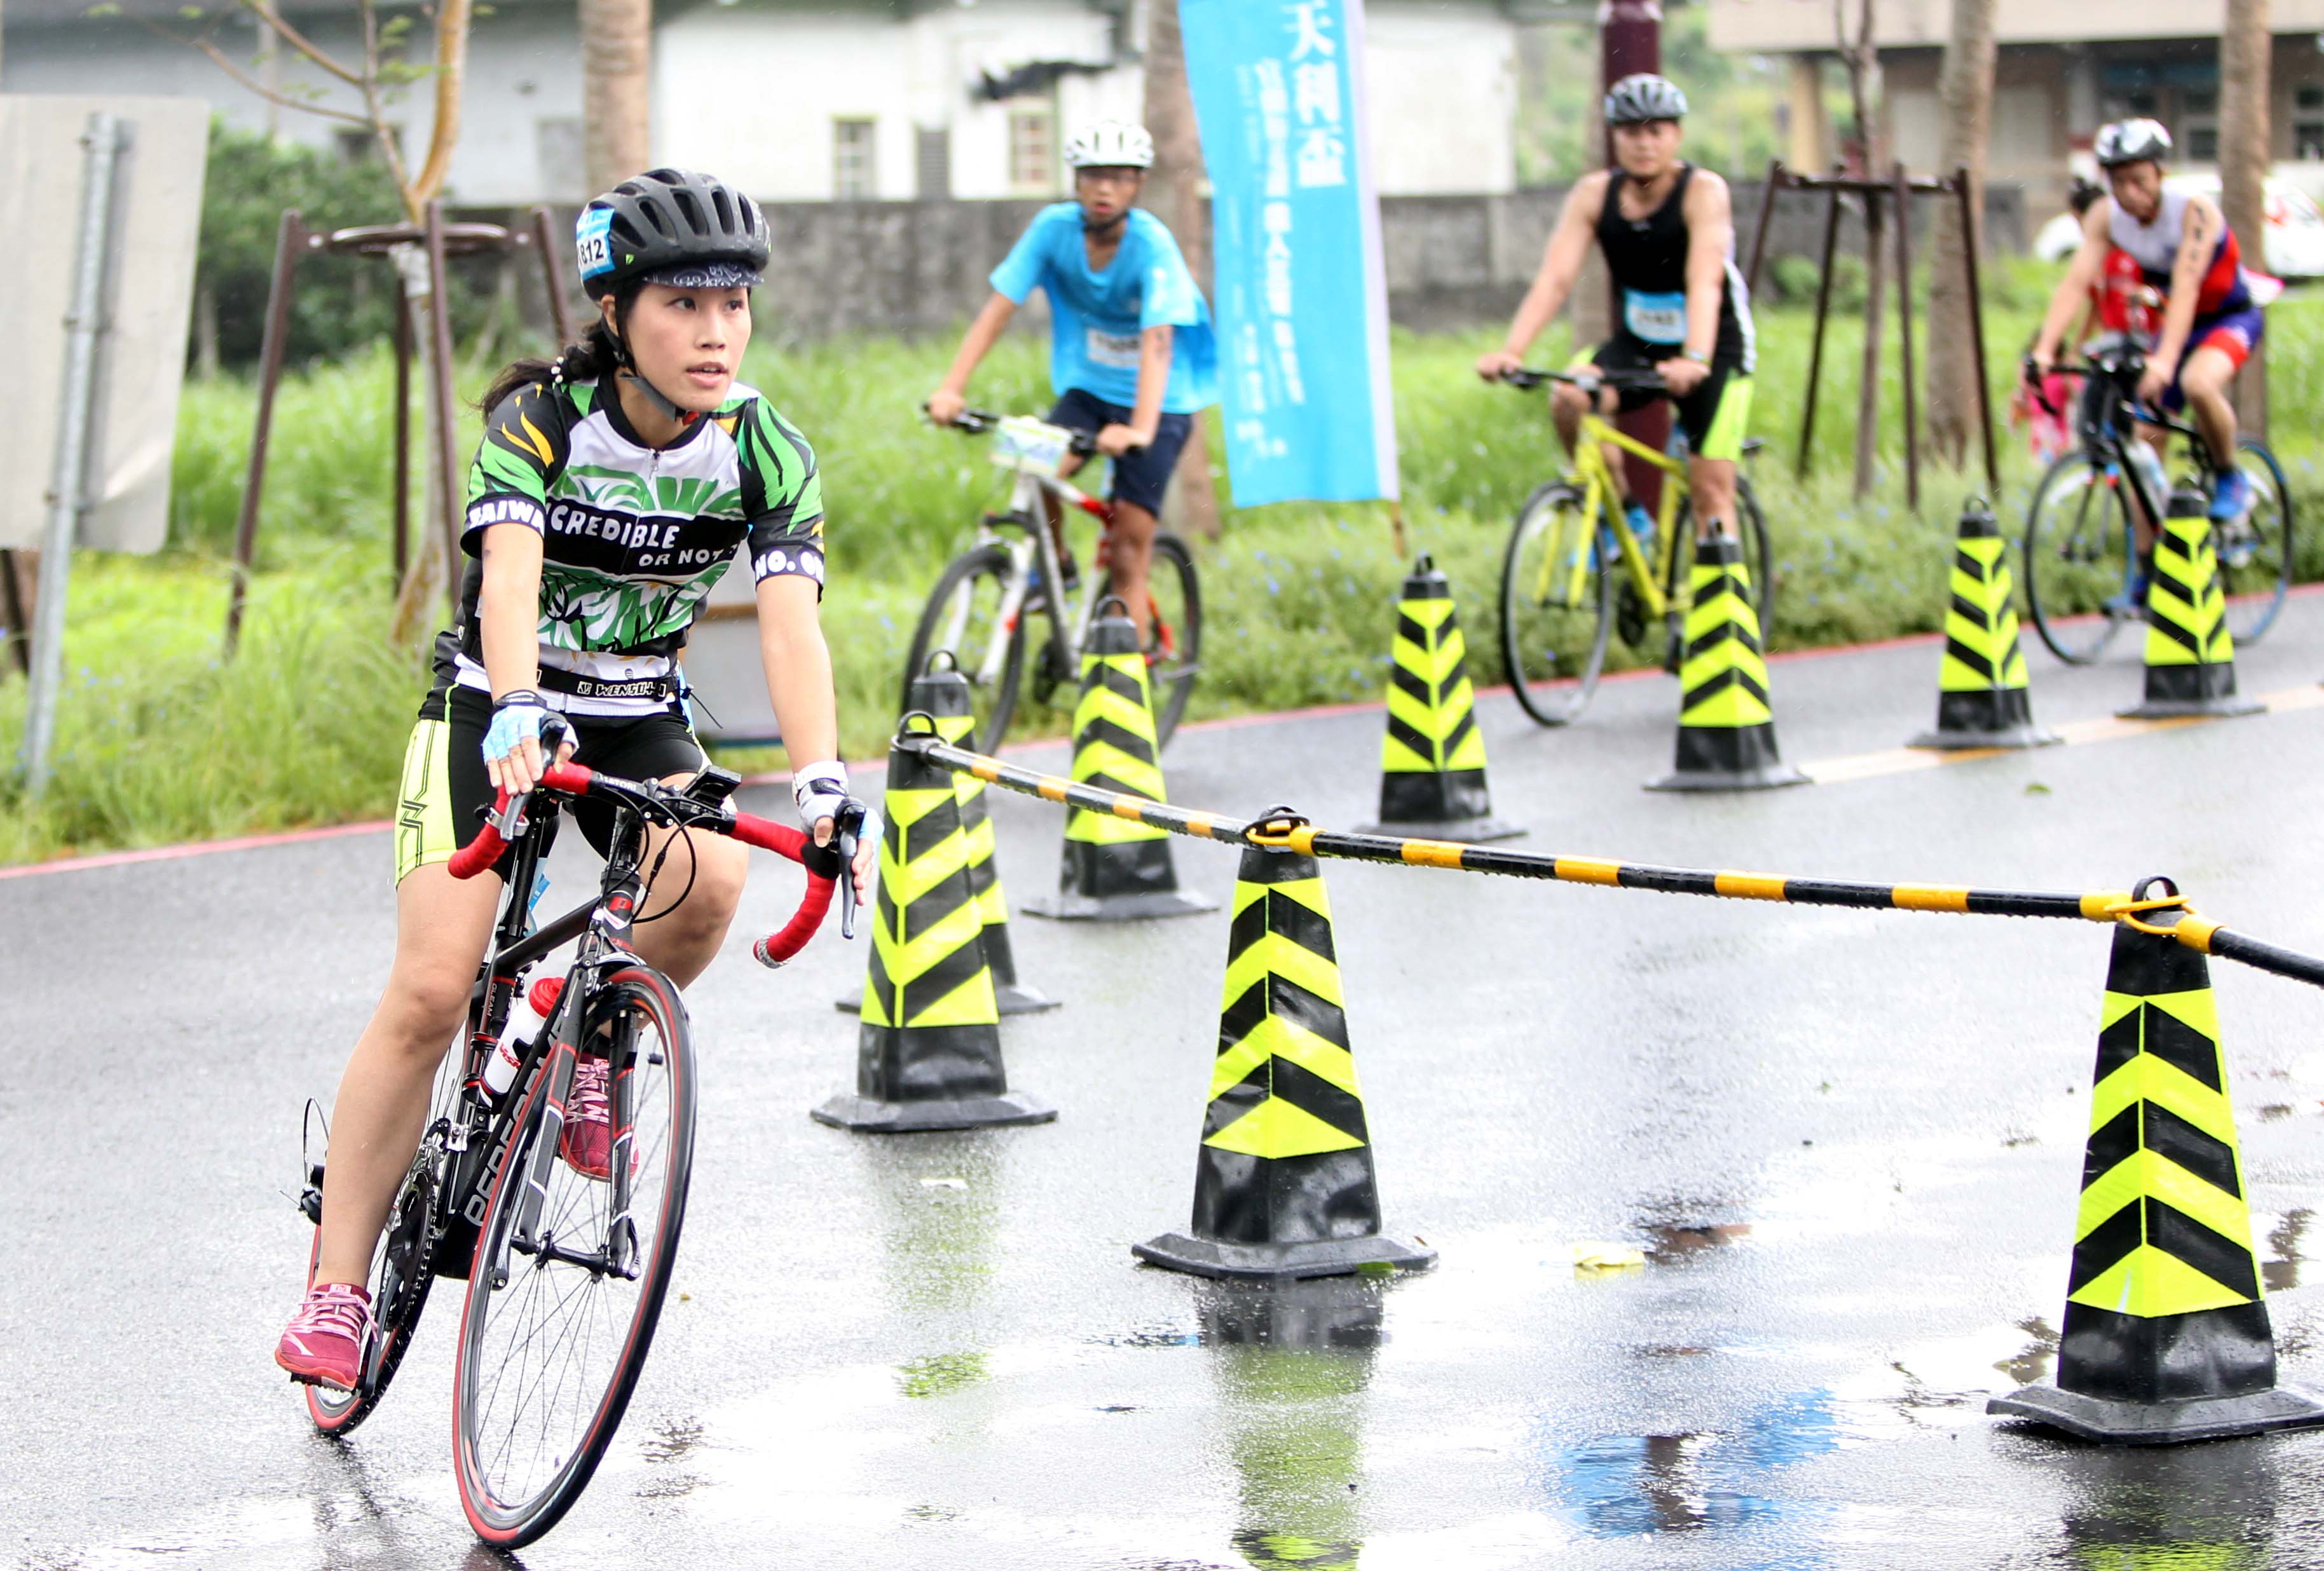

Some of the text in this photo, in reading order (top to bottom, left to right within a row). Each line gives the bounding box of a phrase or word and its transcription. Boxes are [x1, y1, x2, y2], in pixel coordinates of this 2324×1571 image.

[545, 502, 680, 550] CREDIBLE
[639, 553, 671, 567] OR
[755, 550, 796, 582] NO.
[487, 983, 498, 1017] GLEAM
